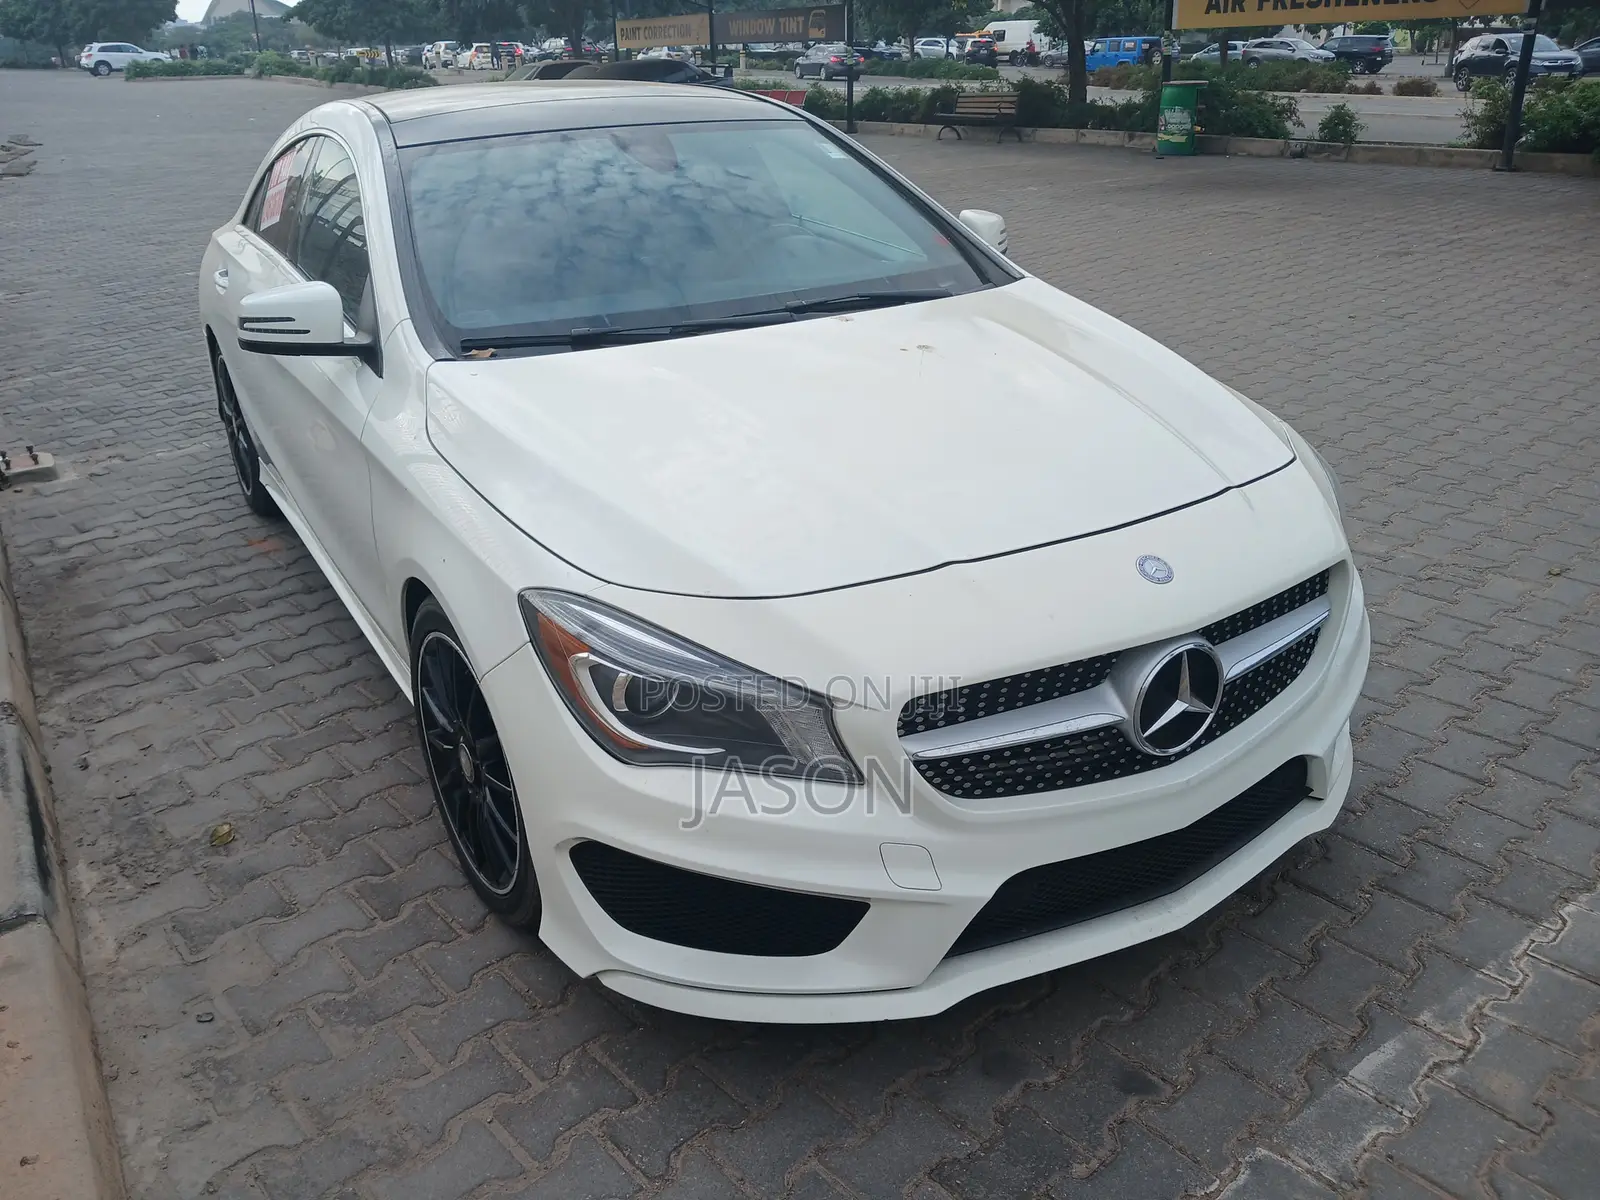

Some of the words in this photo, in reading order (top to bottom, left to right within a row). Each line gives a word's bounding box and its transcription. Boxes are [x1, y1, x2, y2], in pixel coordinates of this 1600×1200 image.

[1204, 0, 1246, 15] AIR
[620, 26, 642, 41] PAINT
[643, 23, 692, 40] CORRECTION
[729, 18, 776, 37] WINDOW
[779, 16, 805, 34] TINT
